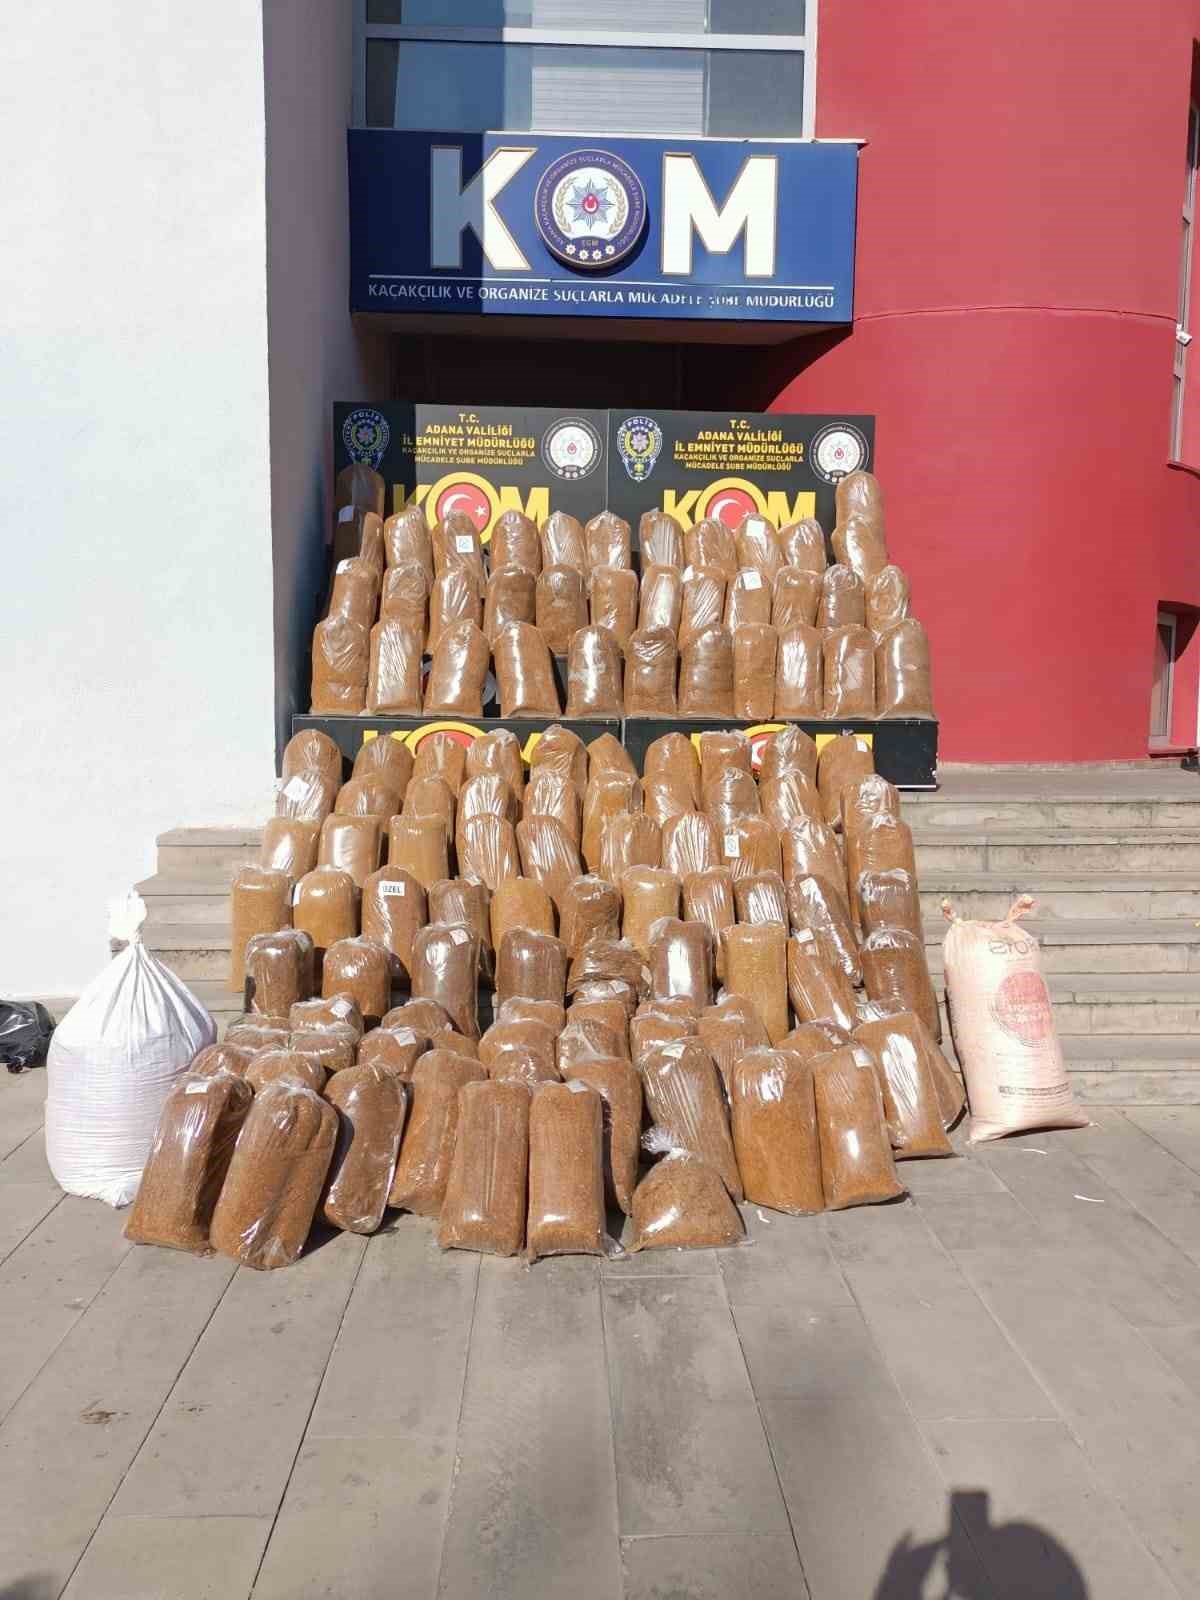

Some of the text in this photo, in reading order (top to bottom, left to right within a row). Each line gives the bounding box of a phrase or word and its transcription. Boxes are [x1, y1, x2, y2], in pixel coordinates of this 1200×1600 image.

[368, 284, 452, 301] KAÇAKÇILIK
[457, 286, 474, 298] VE
[554, 289, 624, 304] SUÇLARLA
[459, 413, 479, 423] T.C.
[425, 424, 512, 435] ADANA VALİLİĞİ
[730, 419, 750, 429] T.C.
[697, 430, 782, 441] ADANA VALİLİĞİ
[416, 436, 465, 447] EMNİYET
[468, 437, 535, 448] MÜDÜRLÜĞÜ
[675, 440, 804, 454] İL EMNİYET MÜDÜRLÜĞÜ
